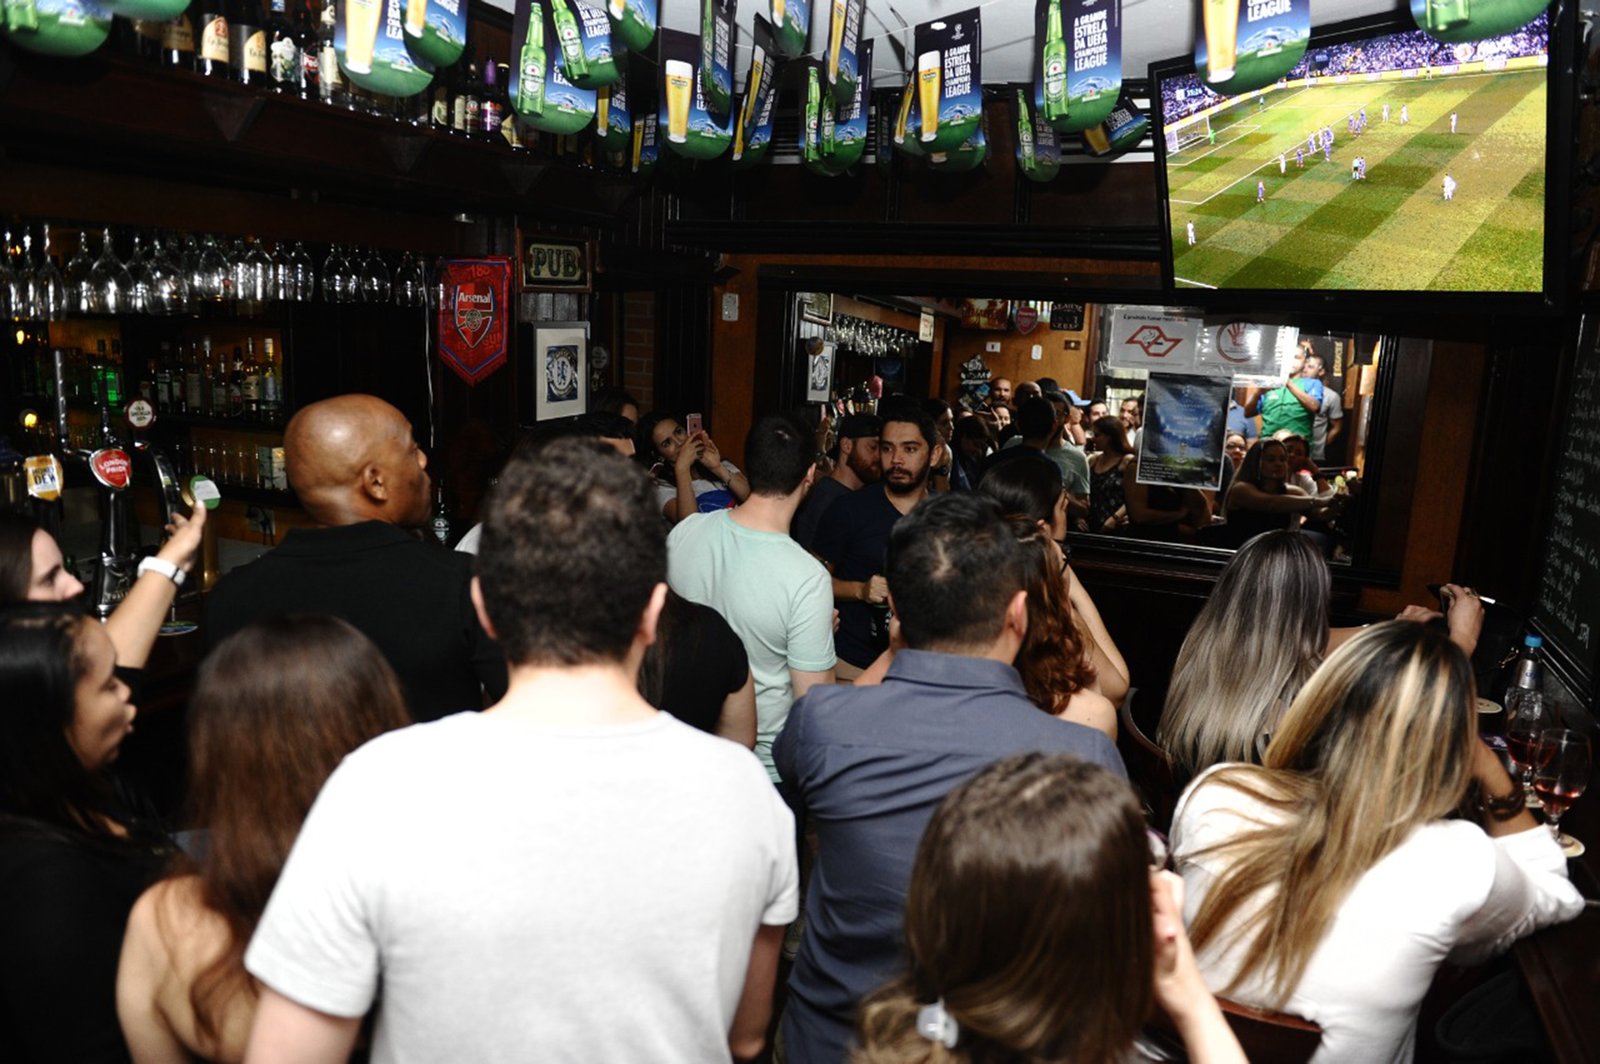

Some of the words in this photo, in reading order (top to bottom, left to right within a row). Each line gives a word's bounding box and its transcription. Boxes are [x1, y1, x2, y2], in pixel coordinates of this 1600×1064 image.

[1080, 9, 1108, 25] GRANDE
[1247, 0, 1292, 22] LEAGUE
[1074, 20, 1108, 39] ESTRELA
[1074, 40, 1086, 51] DA
[1087, 32, 1108, 47] UEFA
[949, 44, 971, 57] GRANDE
[1074, 45, 1108, 59] CHAMPIONS
[944, 53, 971, 68] ESTRELA
[1075, 53, 1108, 72] LEAGUE
[944, 68, 954, 79] DA
[955, 64, 971, 77] UEFA
[945, 84, 971, 98] LEAGUE
[532, 248, 577, 277] PUB
[458, 292, 491, 303] Arsenal
